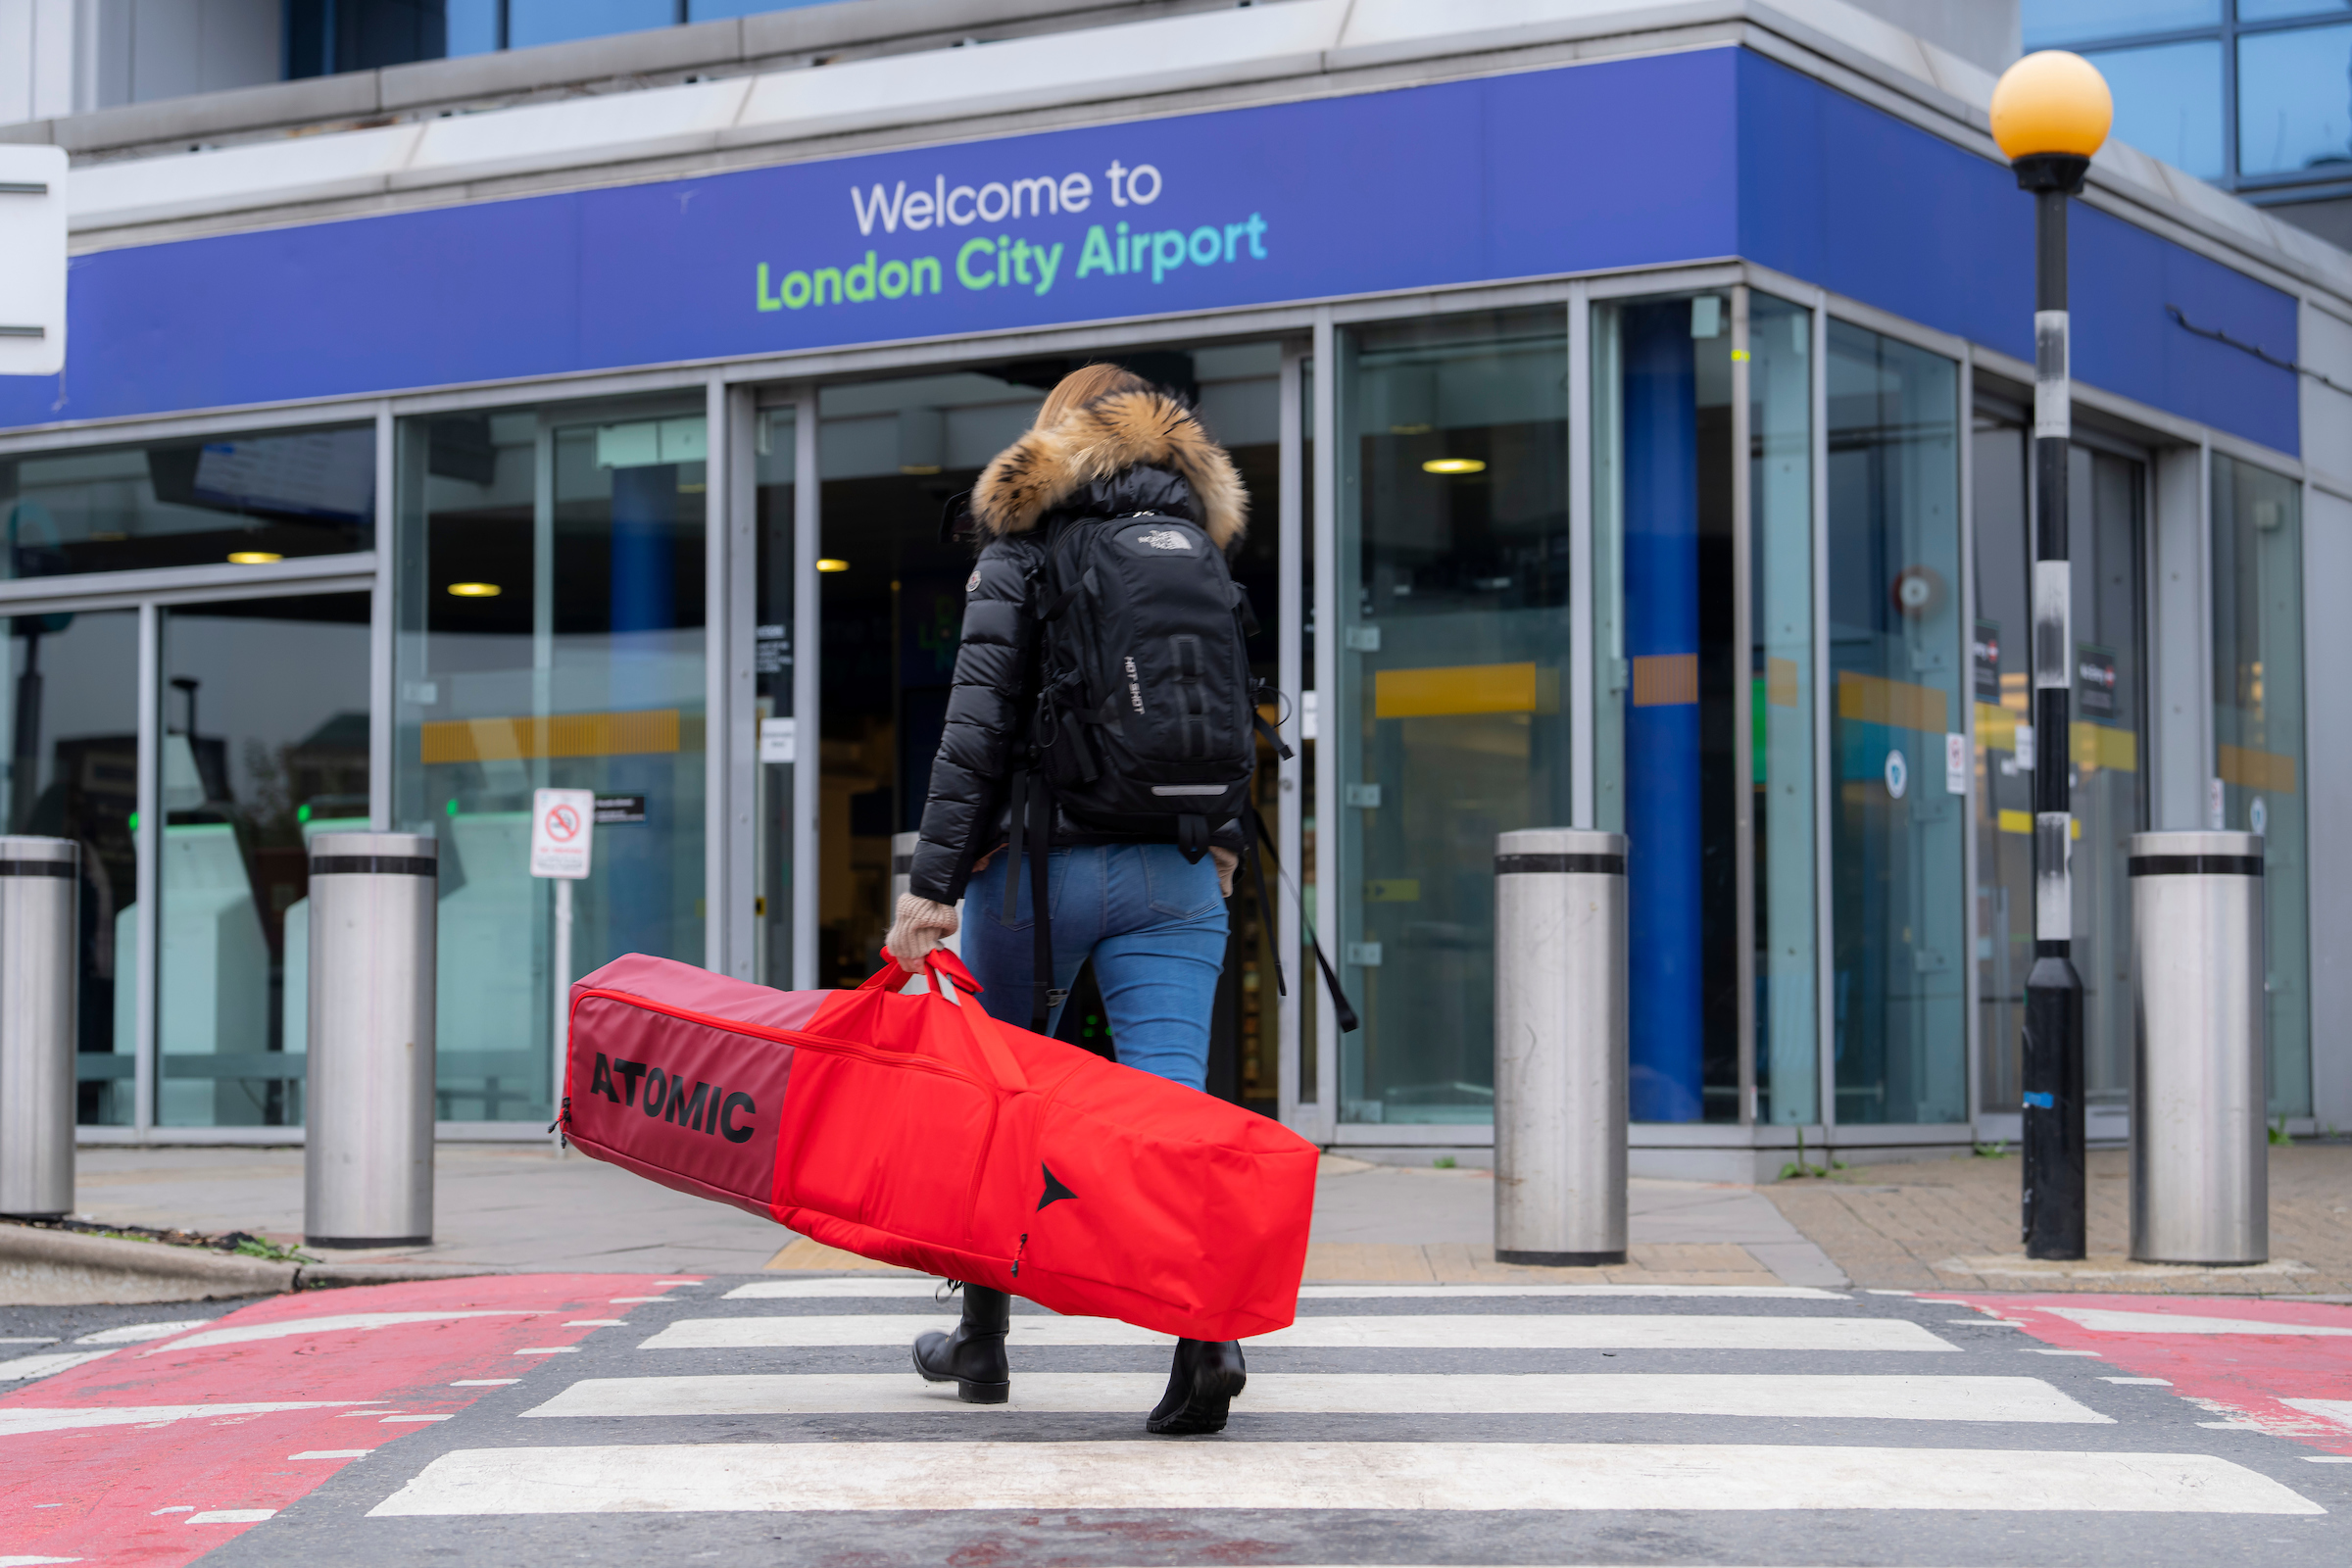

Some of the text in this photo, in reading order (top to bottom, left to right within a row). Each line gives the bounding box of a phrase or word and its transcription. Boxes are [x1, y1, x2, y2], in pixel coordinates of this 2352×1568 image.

[851, 159, 1162, 236] Welcome to
[756, 211, 1269, 313] London City Airport
[1123, 656, 1146, 714] HOT SHOT
[590, 1052, 757, 1144] ATOMIC
